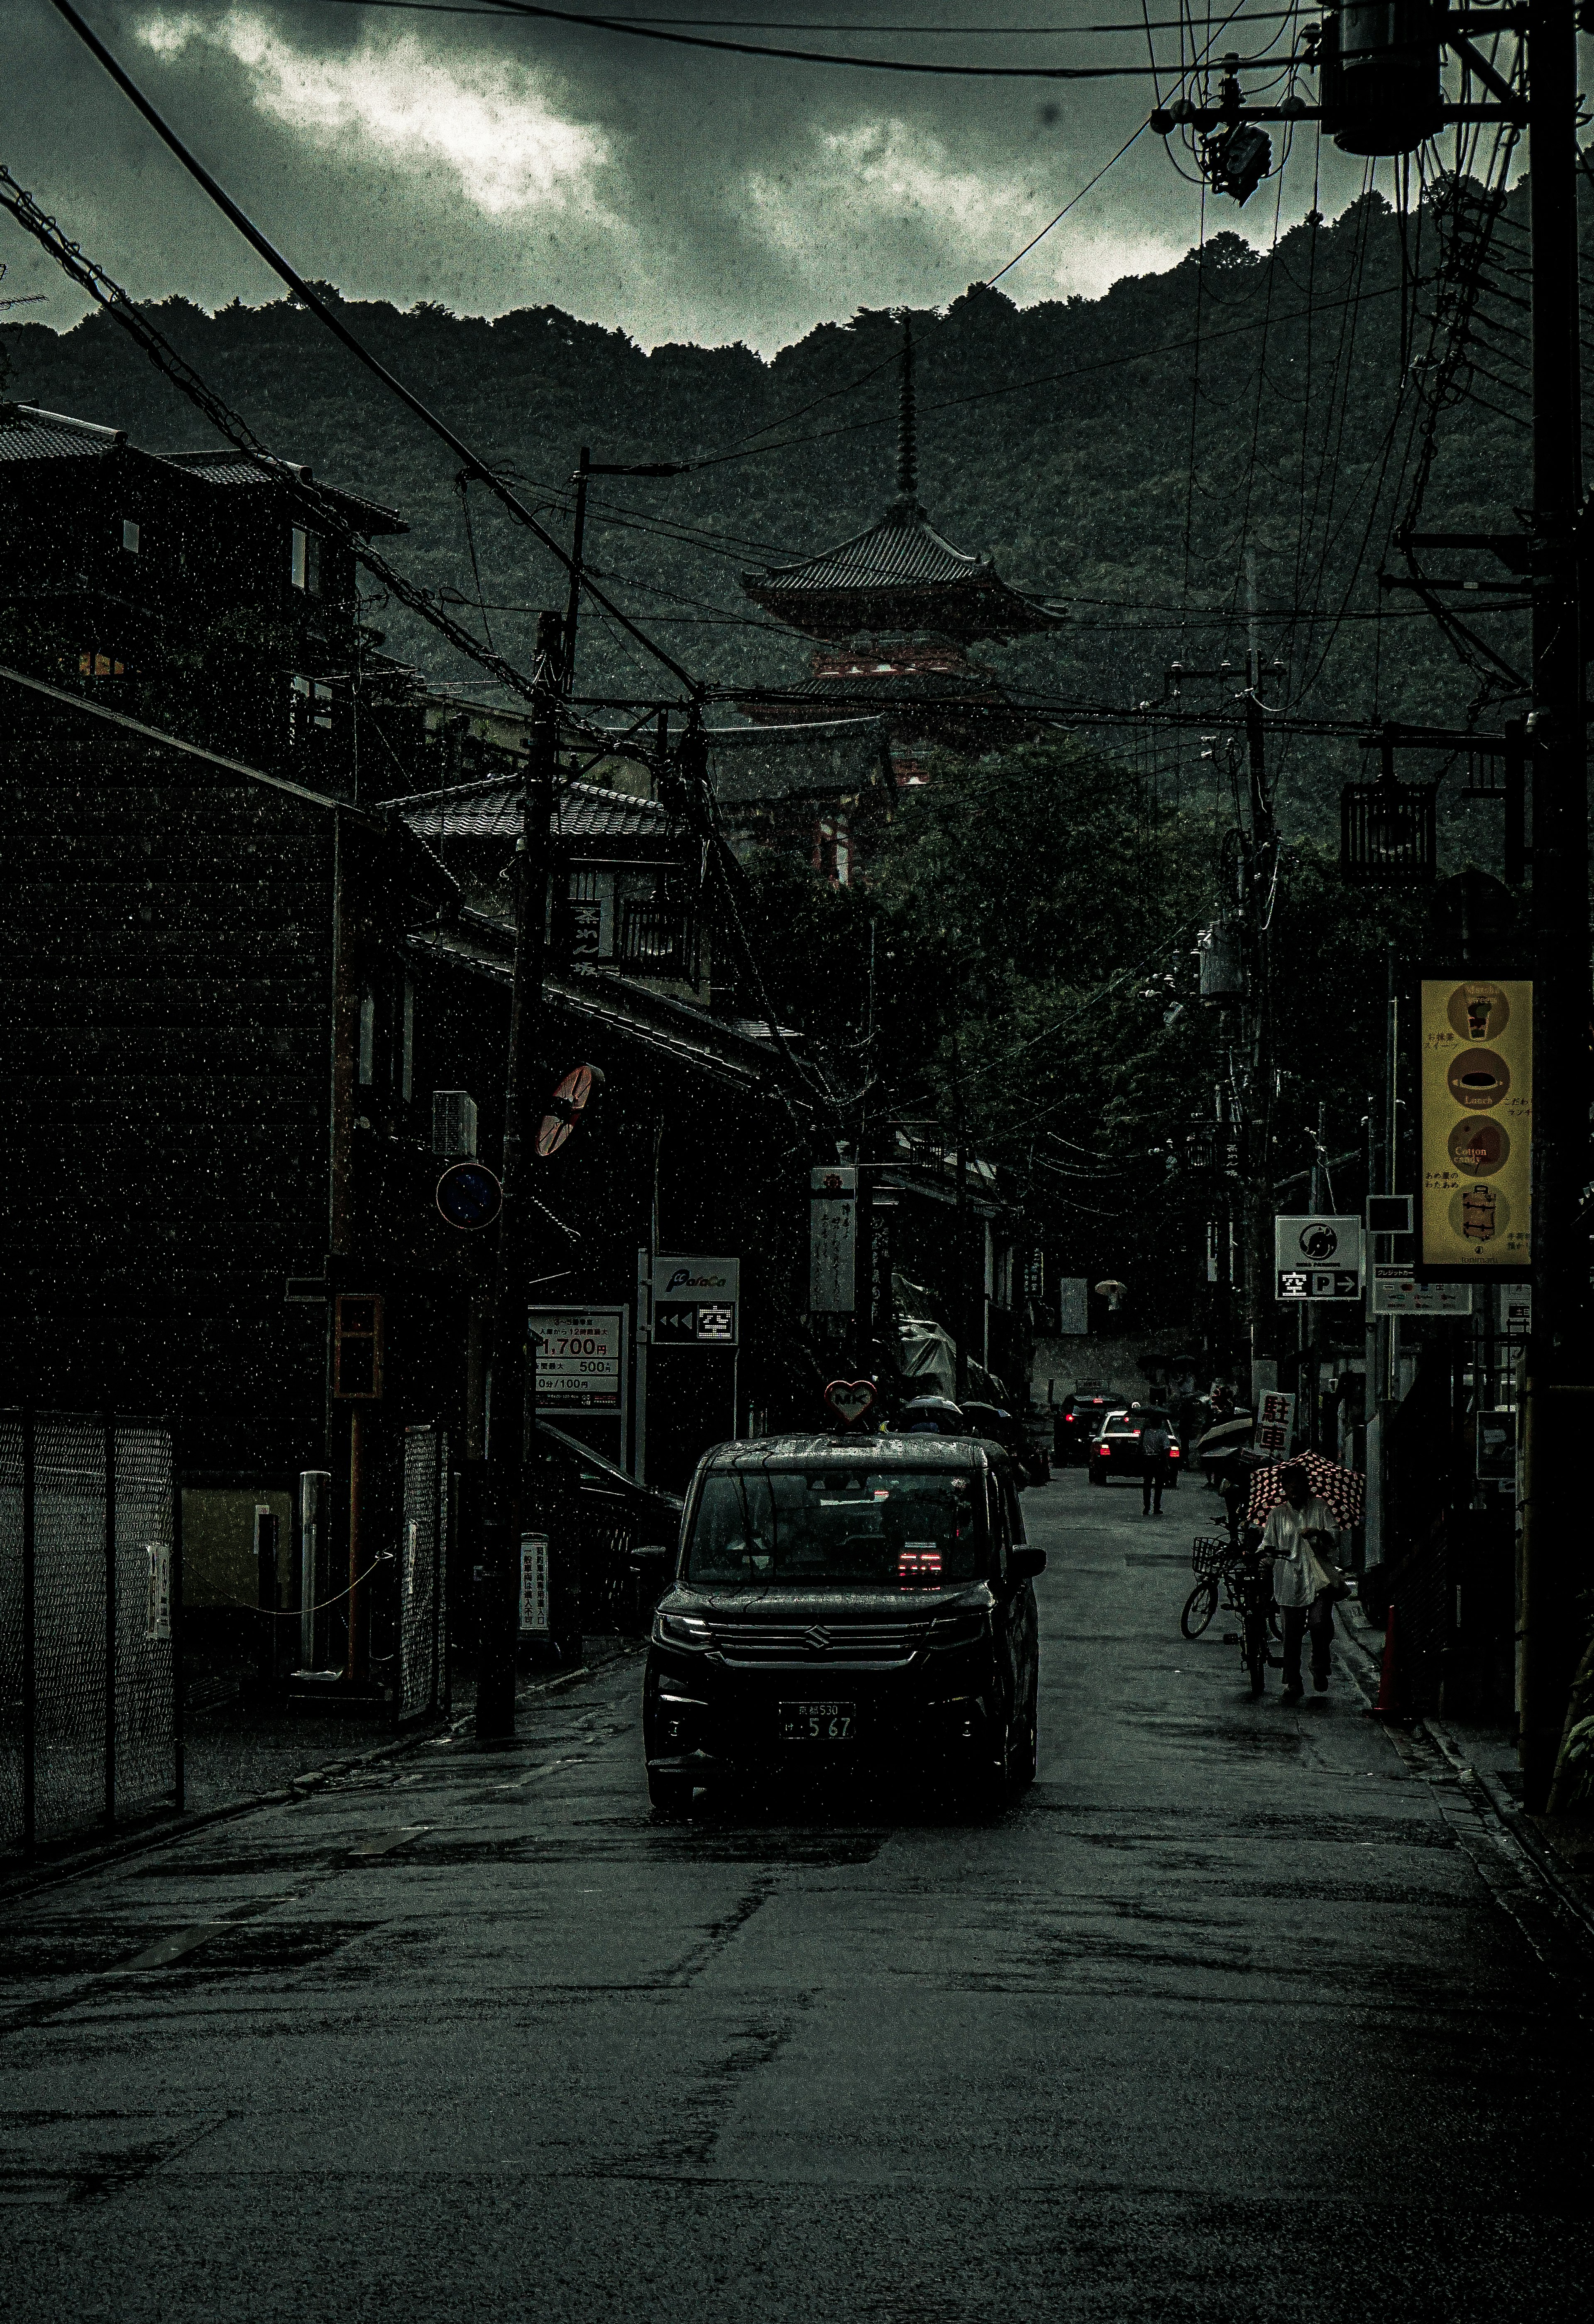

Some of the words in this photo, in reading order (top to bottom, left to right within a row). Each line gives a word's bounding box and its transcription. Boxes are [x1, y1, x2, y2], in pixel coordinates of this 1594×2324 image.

[570, 910, 599, 976] 茶わん坂
[1464, 1096, 1493, 1104] Lunch
[1504, 1097, 1532, 1106] こだわ
[1454, 1155, 1482, 1164] candy
[1455, 1146, 1487, 1156] Cotton
[1282, 1272, 1307, 1296] 空
[699, 1306, 731, 1337] 空
[835, 1394, 867, 1405] MK
[1260, 1395, 1290, 1459] 駐車
[524, 1549, 533, 1625] 一般車両は進入不可
